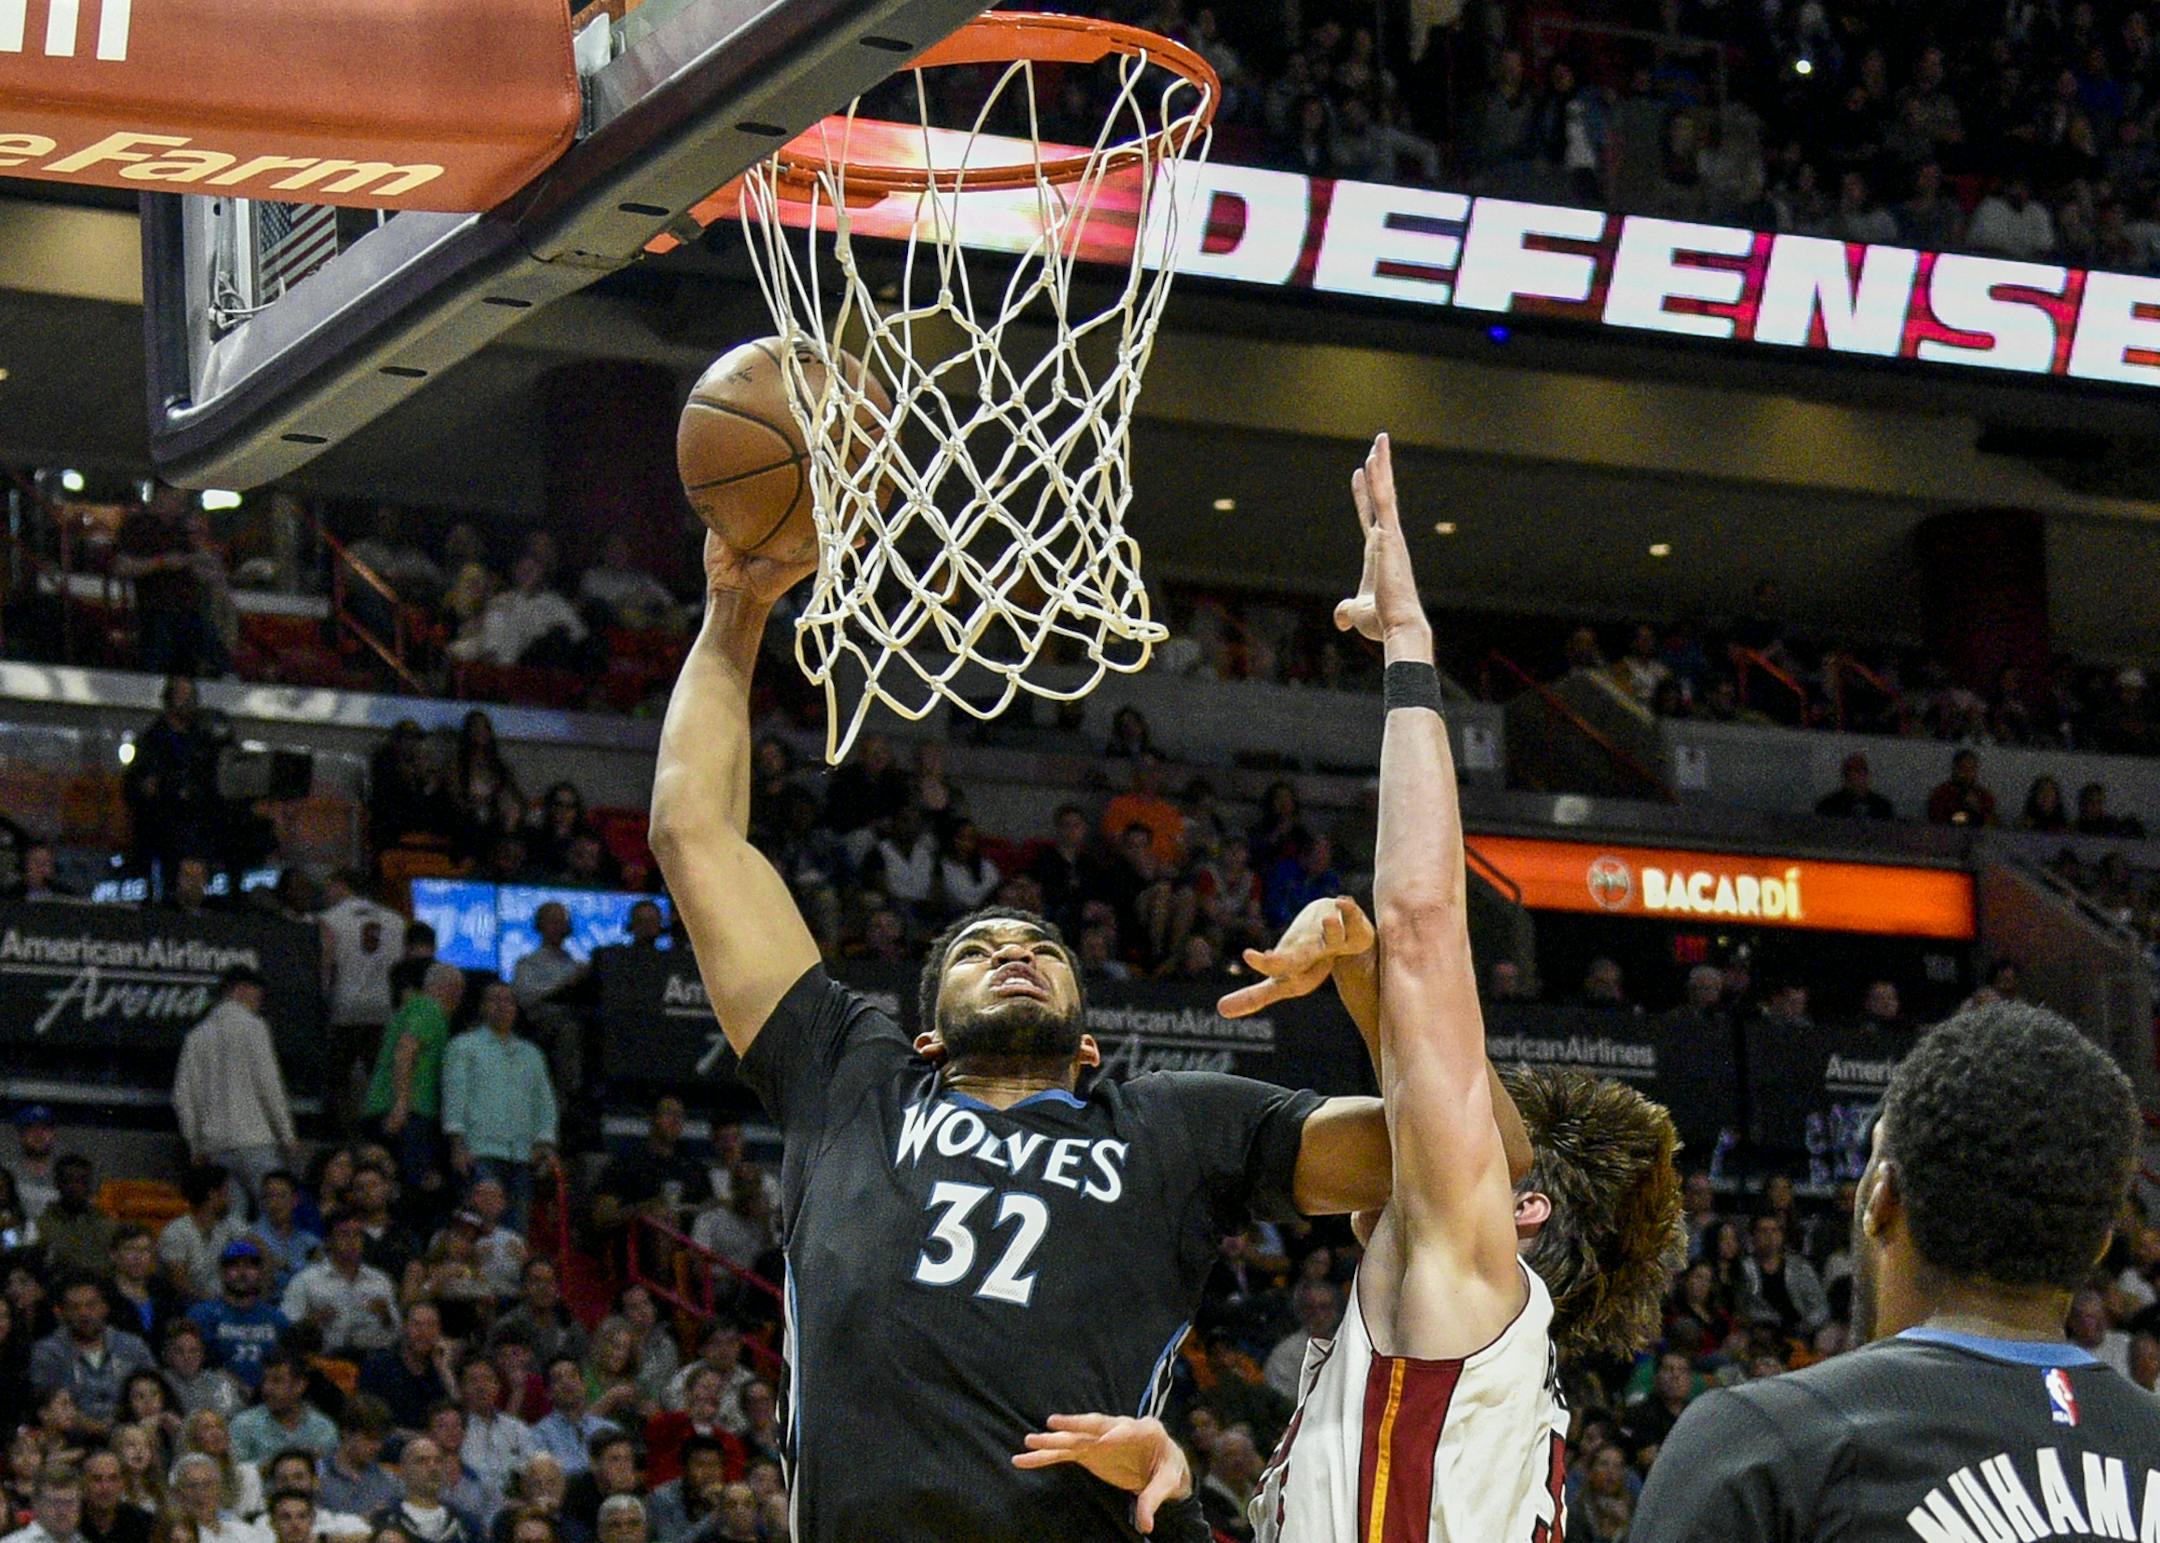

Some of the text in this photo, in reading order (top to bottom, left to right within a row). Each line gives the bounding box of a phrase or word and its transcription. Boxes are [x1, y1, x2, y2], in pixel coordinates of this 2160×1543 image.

[1140, 157, 2160, 387] DEFENSE
[895, 1101, 1131, 1203] WOLVES
[912, 1181, 1049, 1307] 32
